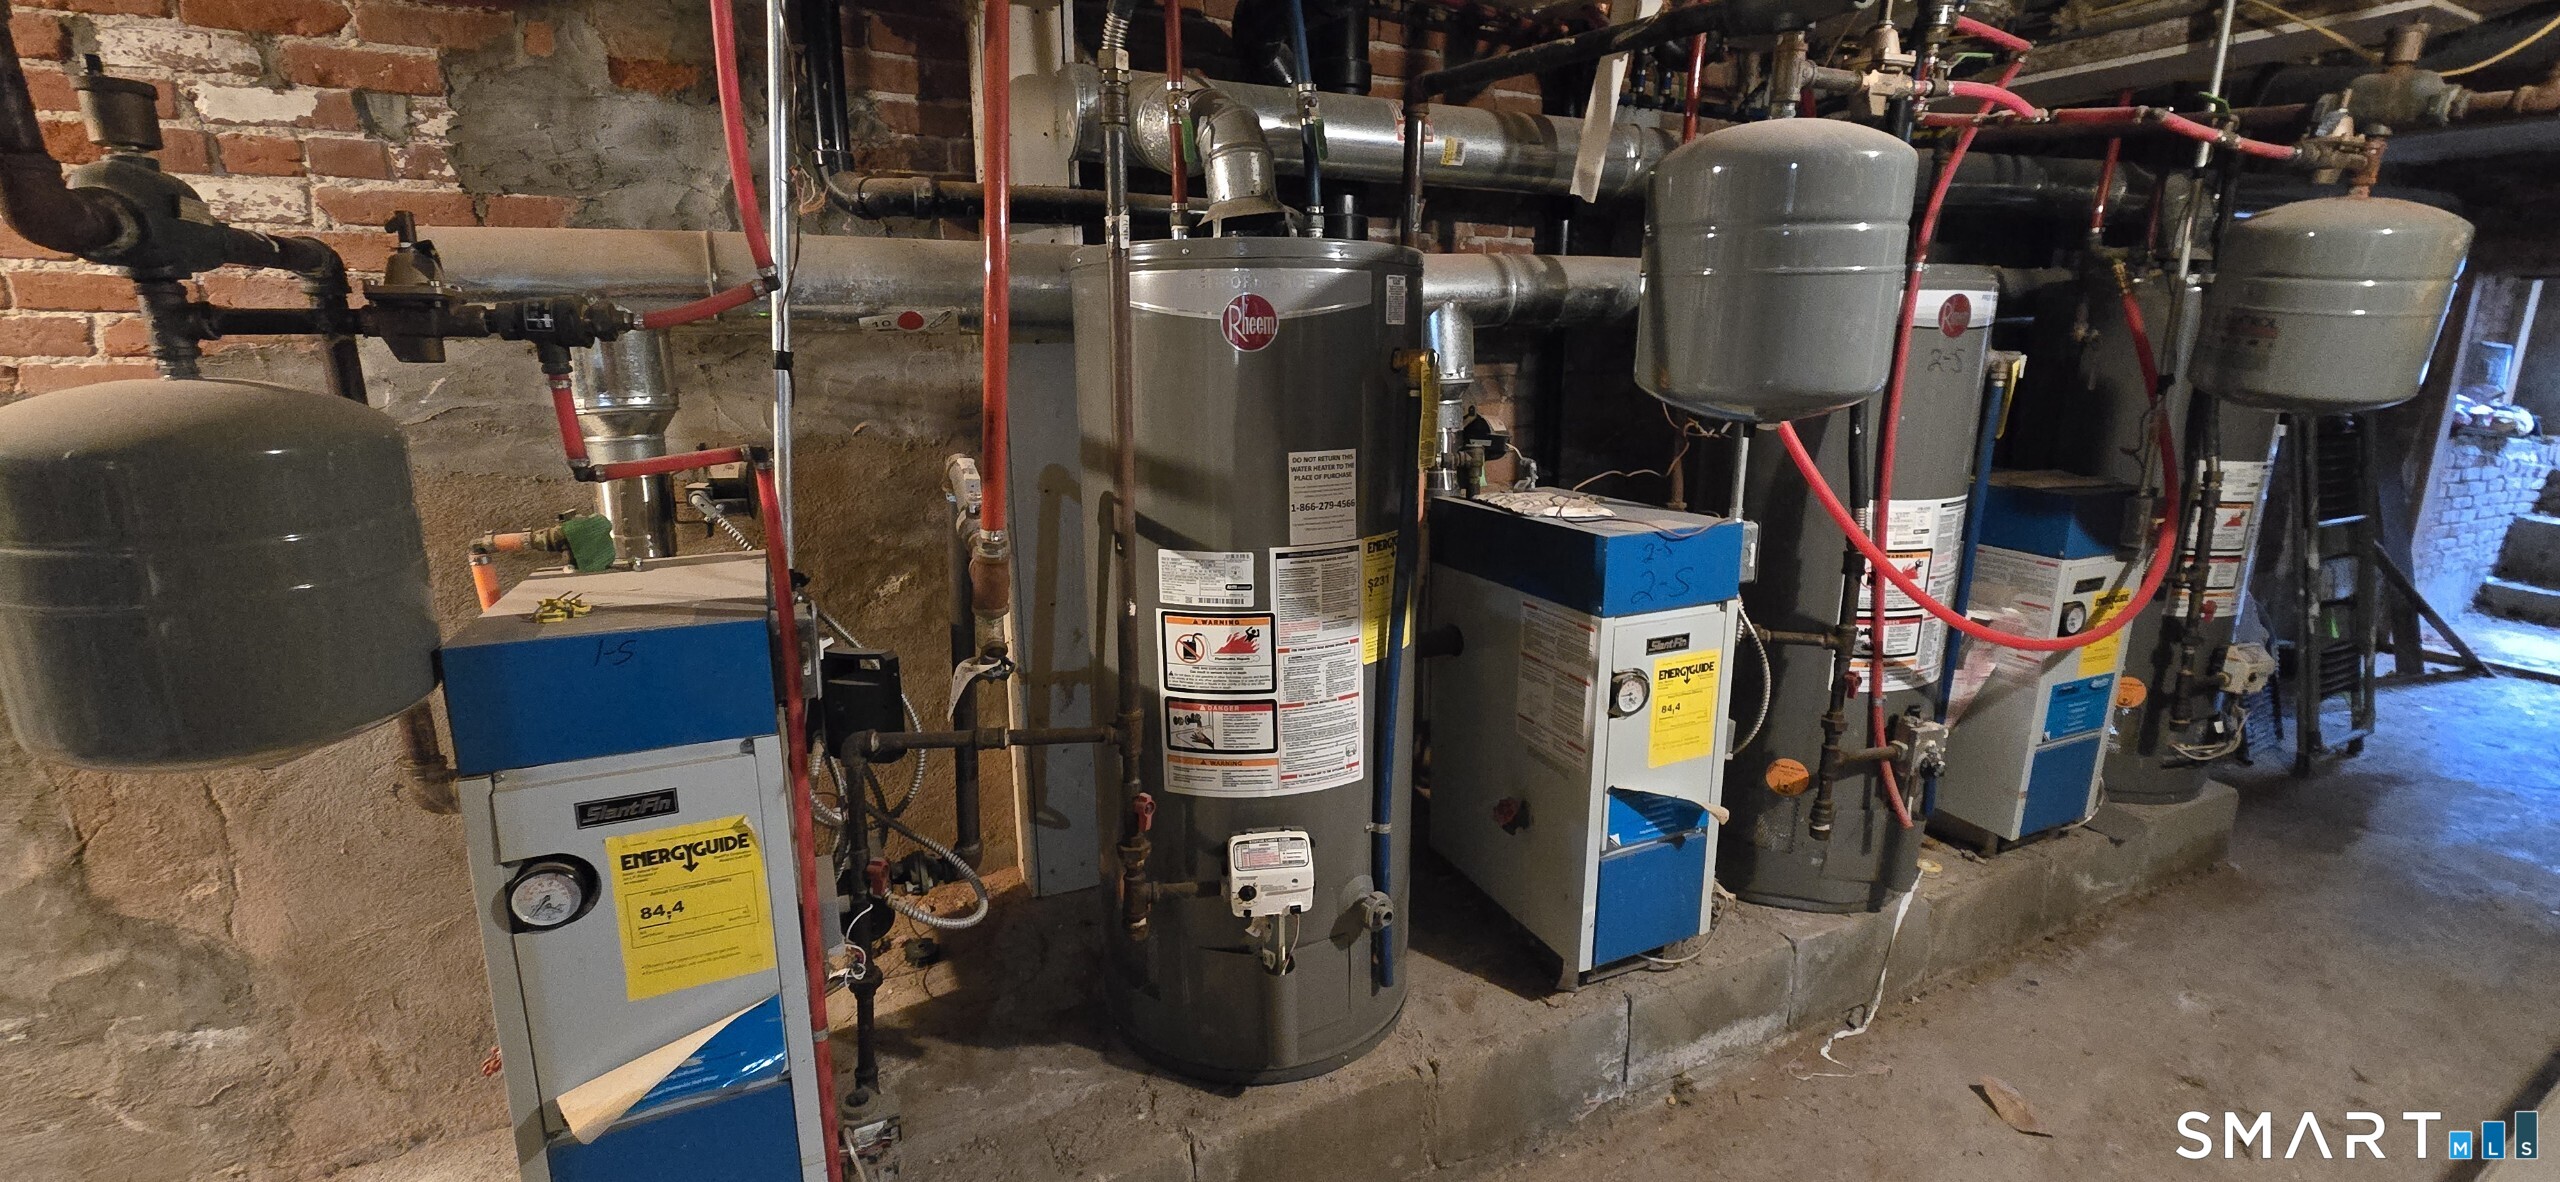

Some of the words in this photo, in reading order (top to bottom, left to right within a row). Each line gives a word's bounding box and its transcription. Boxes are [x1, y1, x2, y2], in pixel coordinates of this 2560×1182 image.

[1228, 294, 1275, 342] Rheem
[1318, 454, 1341, 462] RETURN
[1291, 465, 1312, 473] WATER
[1323, 471, 1352, 480] PURCHASE
[1291, 498, 1356, 512] 1-866-279-4566
[1368, 574, 1390, 588] $231
[1658, 661, 1715, 681] ENERGYGUIDE
[620, 832, 750, 872] ENERGYGUIDE
[640, 900, 685, 920] 84.4
